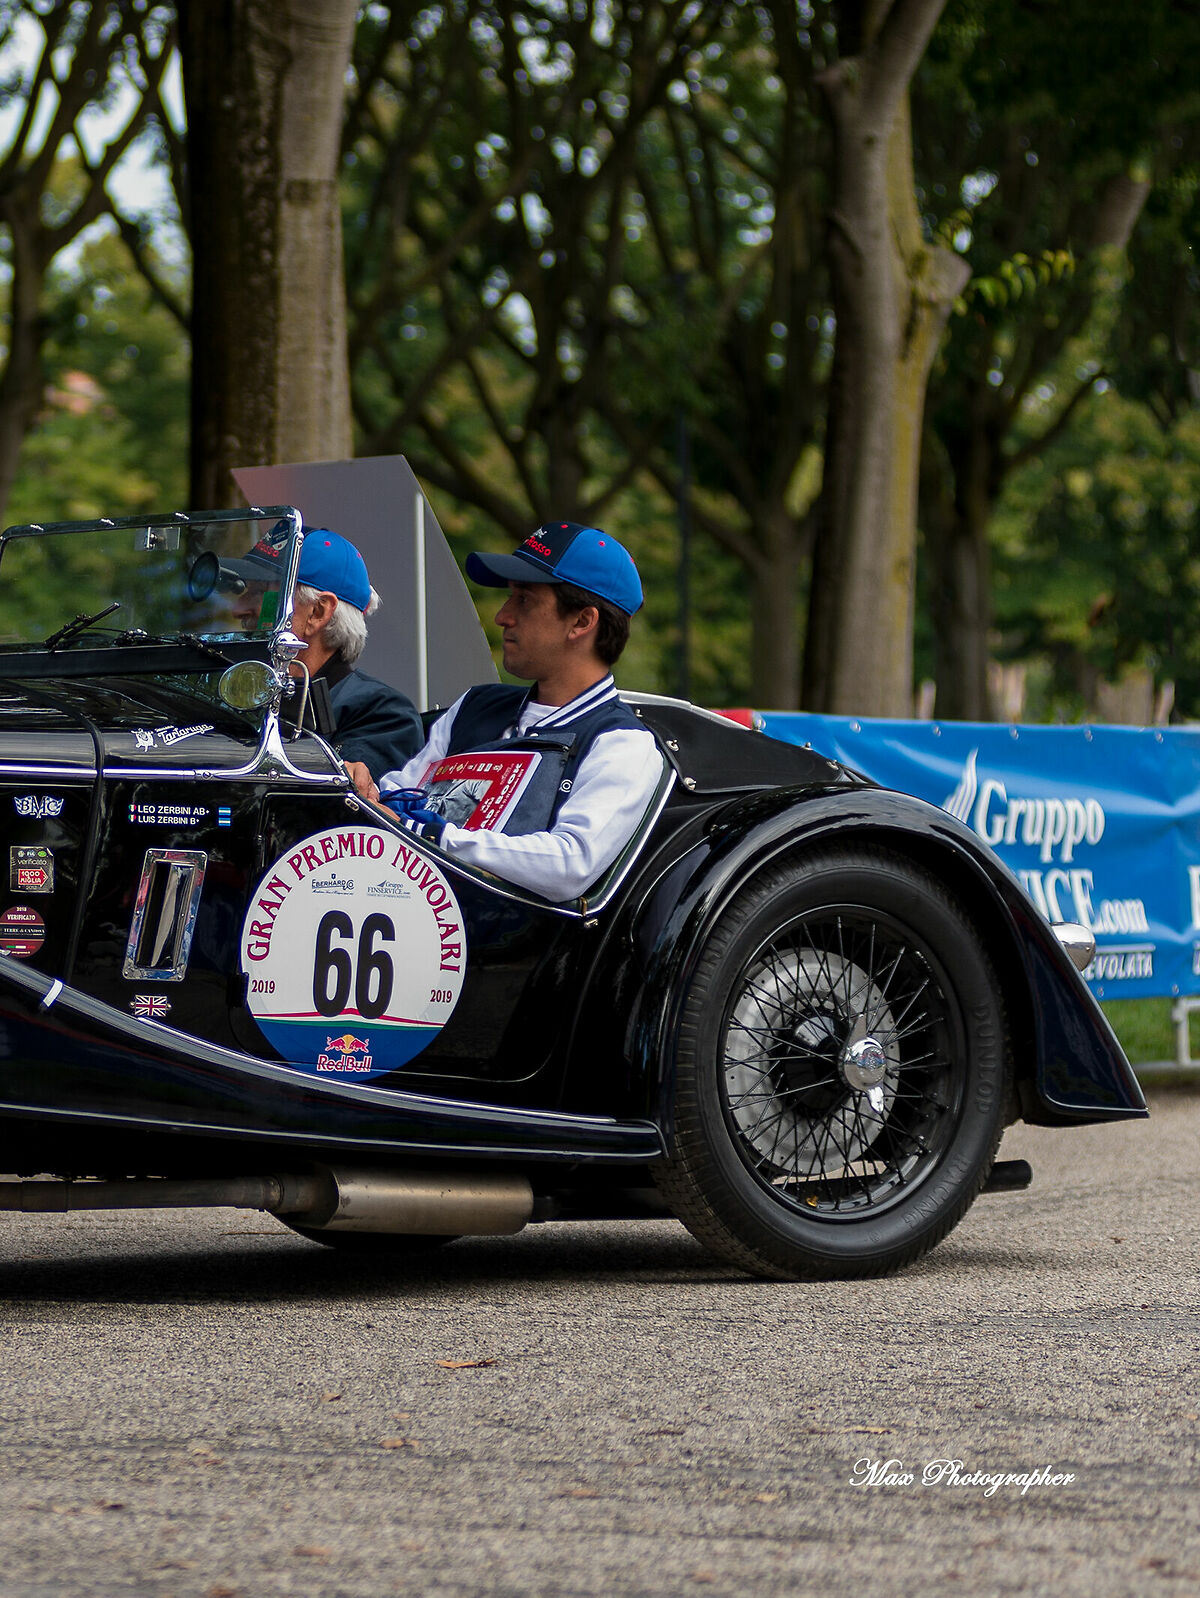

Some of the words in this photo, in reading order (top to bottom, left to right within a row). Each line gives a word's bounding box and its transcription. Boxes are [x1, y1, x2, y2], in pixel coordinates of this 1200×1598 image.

[137, 804, 156, 814] LEO
[157, 805, 191, 815] ZERBINI
[137, 815, 156, 824] LUIS
[157, 816, 188, 825] ZERBINI
[974, 778, 1105, 864] Gruppo
[246, 874, 293, 961] GRAN
[287, 832, 385, 881] PREMIO
[391, 844, 462, 973] NUVOLARI
[312, 909, 396, 1020] 66
[1084, 951, 1153, 981] EVOLATA
[251, 979, 276, 994] 2019
[430, 989, 453, 1004] 2019
[317, 1054, 346, 1072] Red
[345, 1055, 373, 1073] Bull
